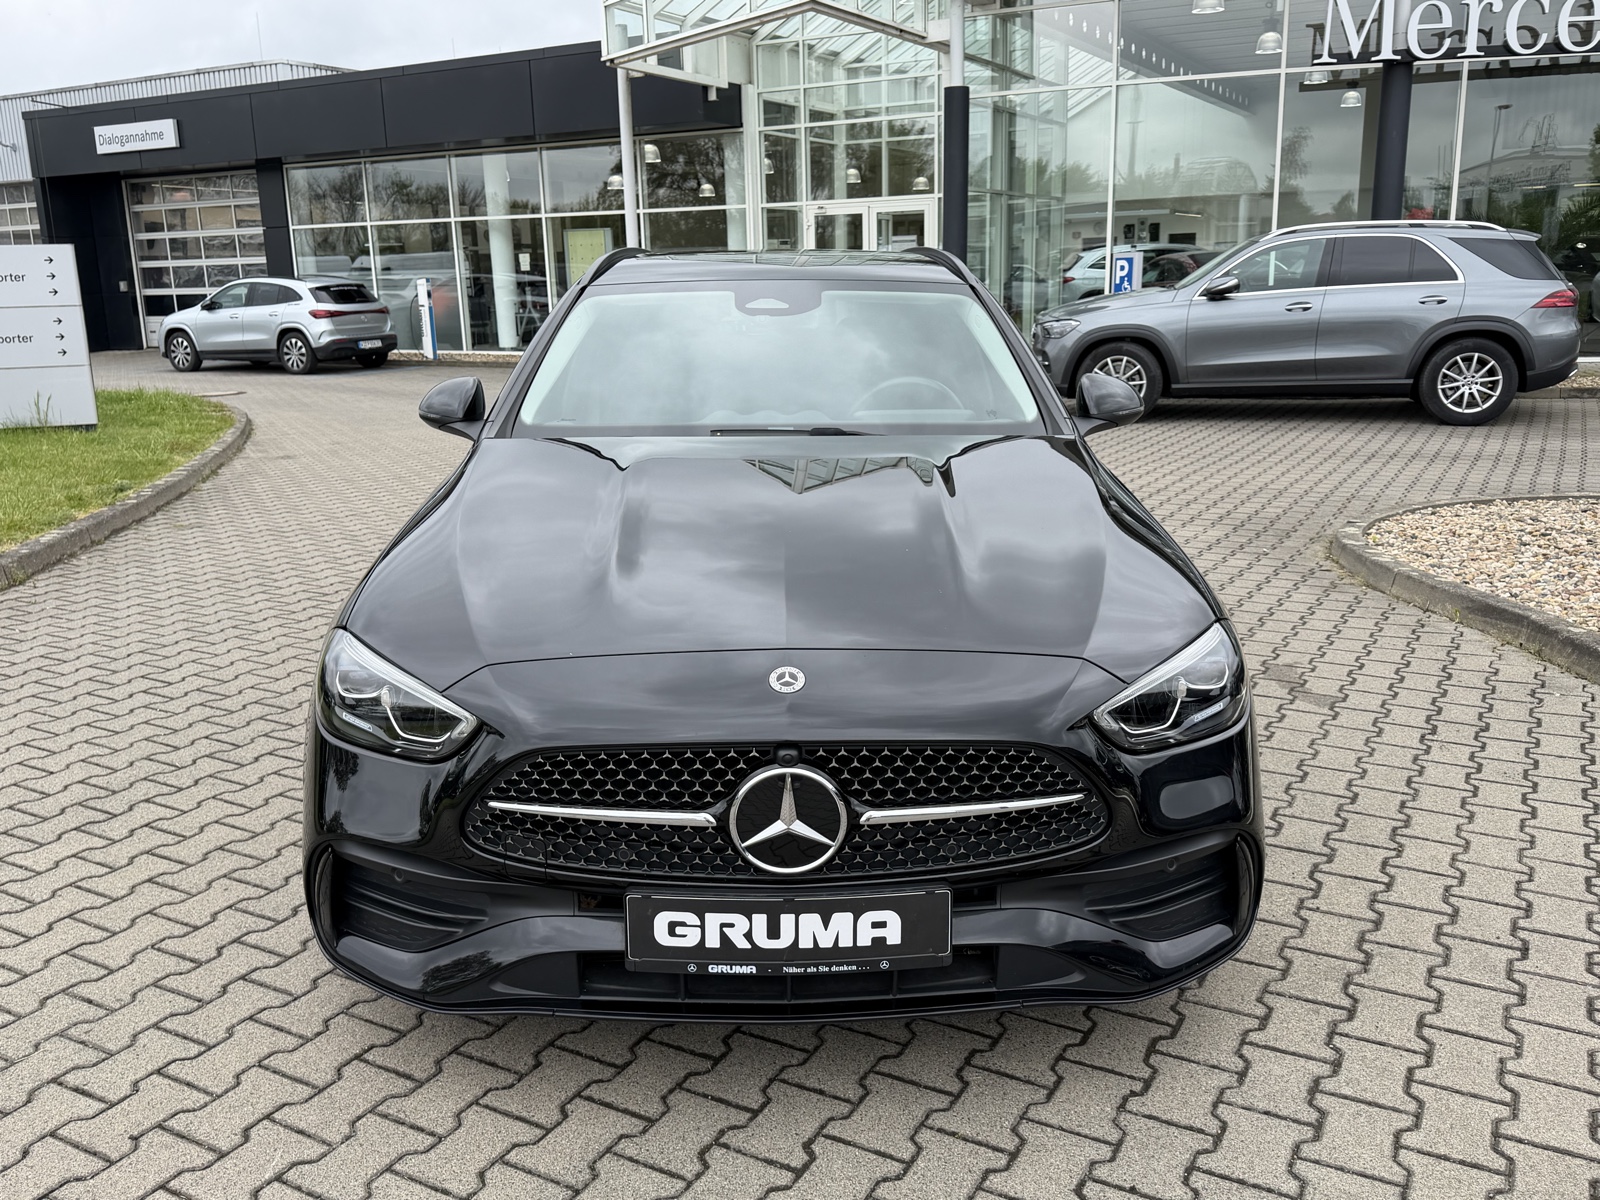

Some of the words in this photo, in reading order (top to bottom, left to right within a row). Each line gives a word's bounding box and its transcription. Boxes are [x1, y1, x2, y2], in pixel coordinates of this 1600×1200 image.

[1312, 0, 1600, 64] Merce
[98, 129, 164, 148] Dialogannahme
[1115, 259, 1129, 285] P
[653, 909, 902, 949] GRUMA
[708, 964, 757, 974] GRUMA
[806, 965, 817, 973] als
[831, 964, 857, 972] denken
